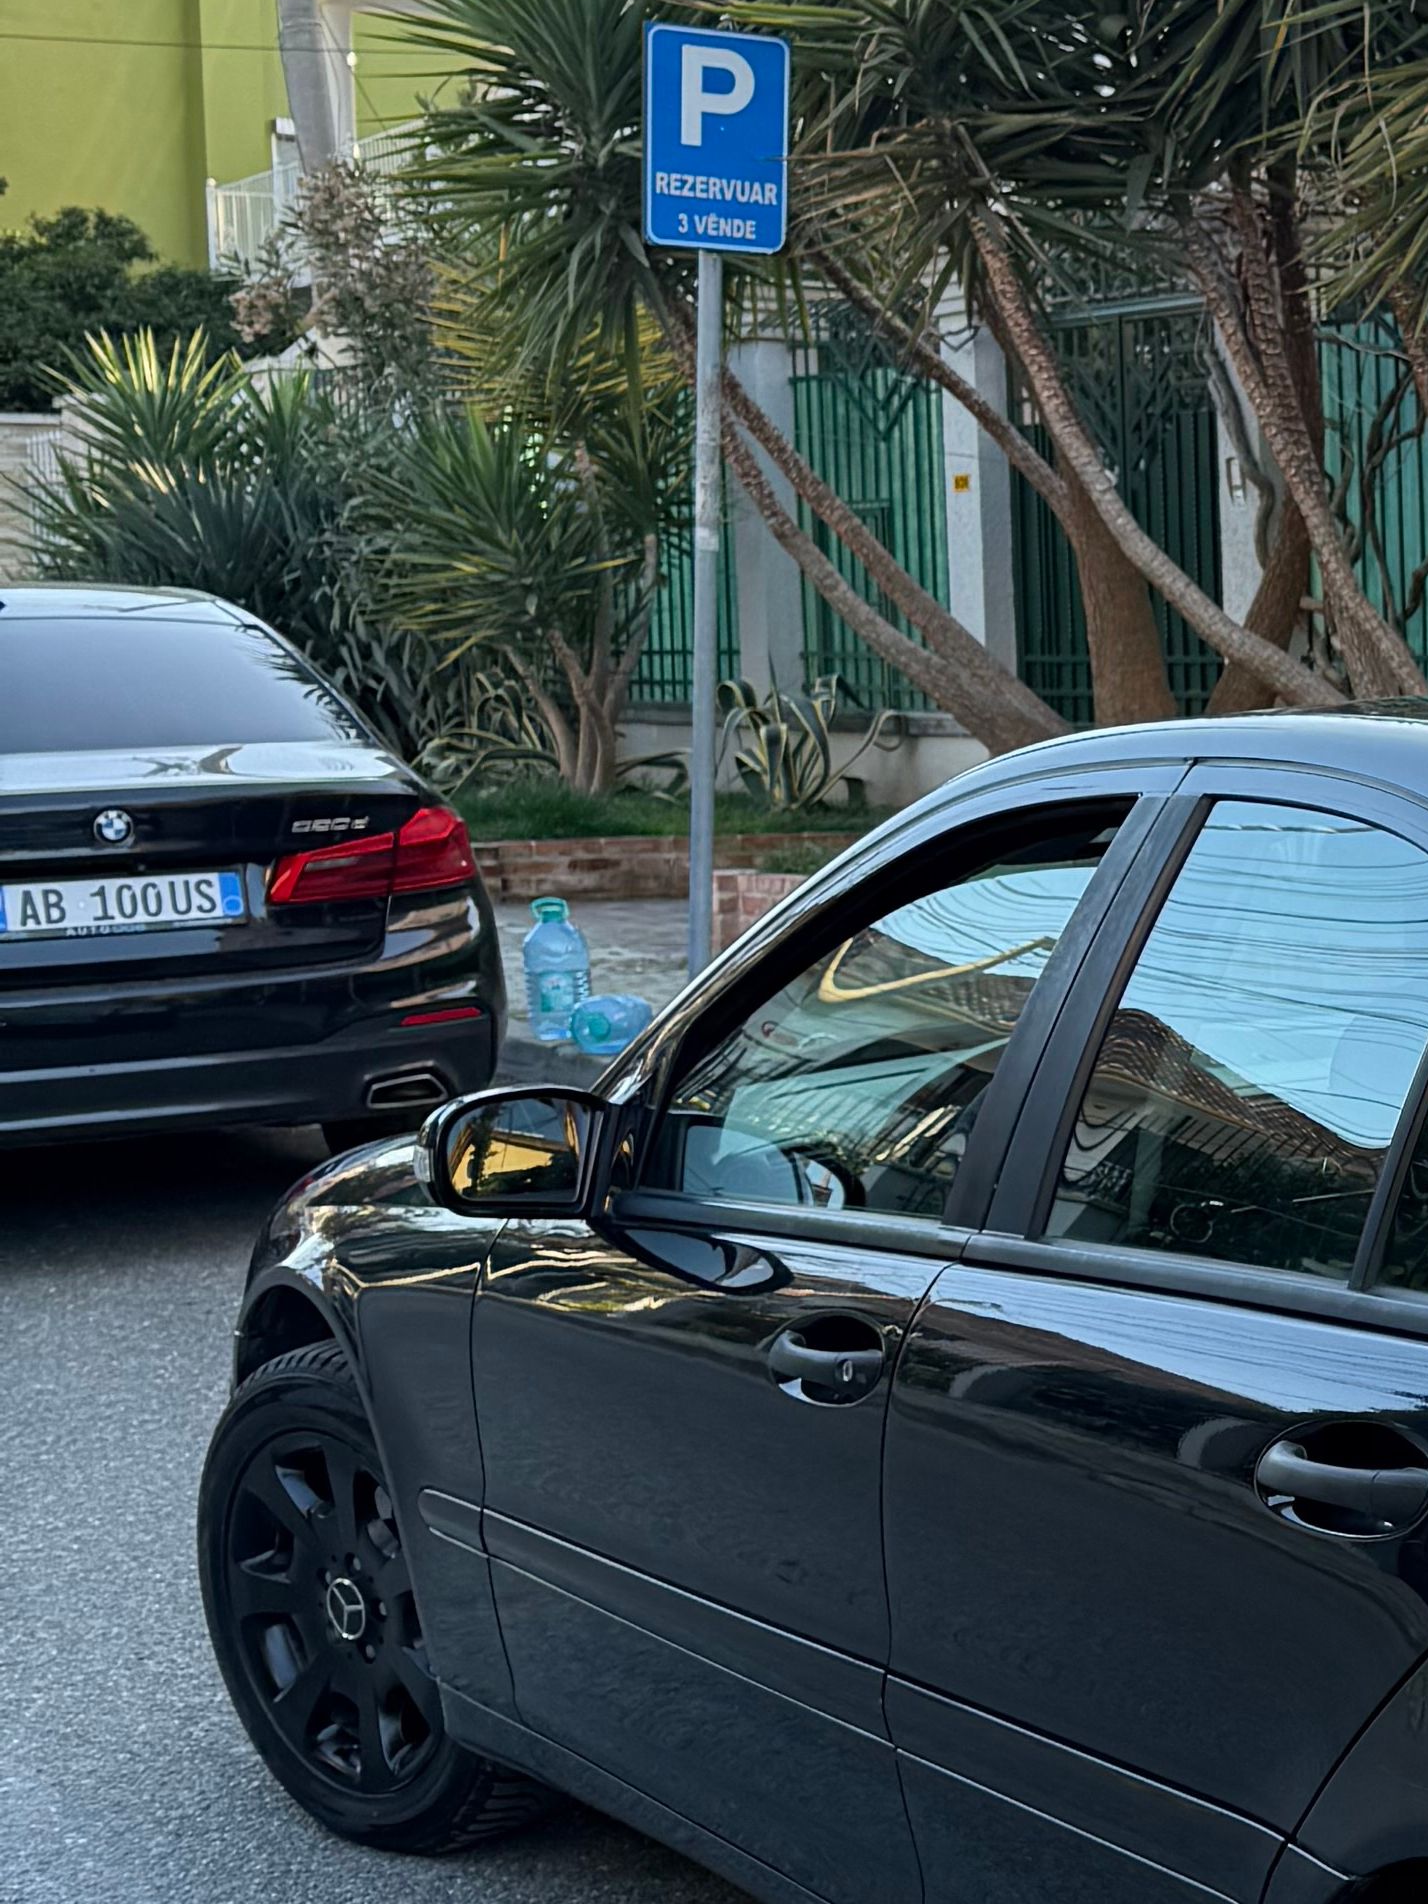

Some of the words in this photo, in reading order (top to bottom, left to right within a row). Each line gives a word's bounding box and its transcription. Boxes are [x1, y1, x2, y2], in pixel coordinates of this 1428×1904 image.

[681, 44, 755, 146] P
[655, 171, 777, 205] REZERVUAR
[678, 213, 689, 234] 3
[19, 889, 66, 927] AB
